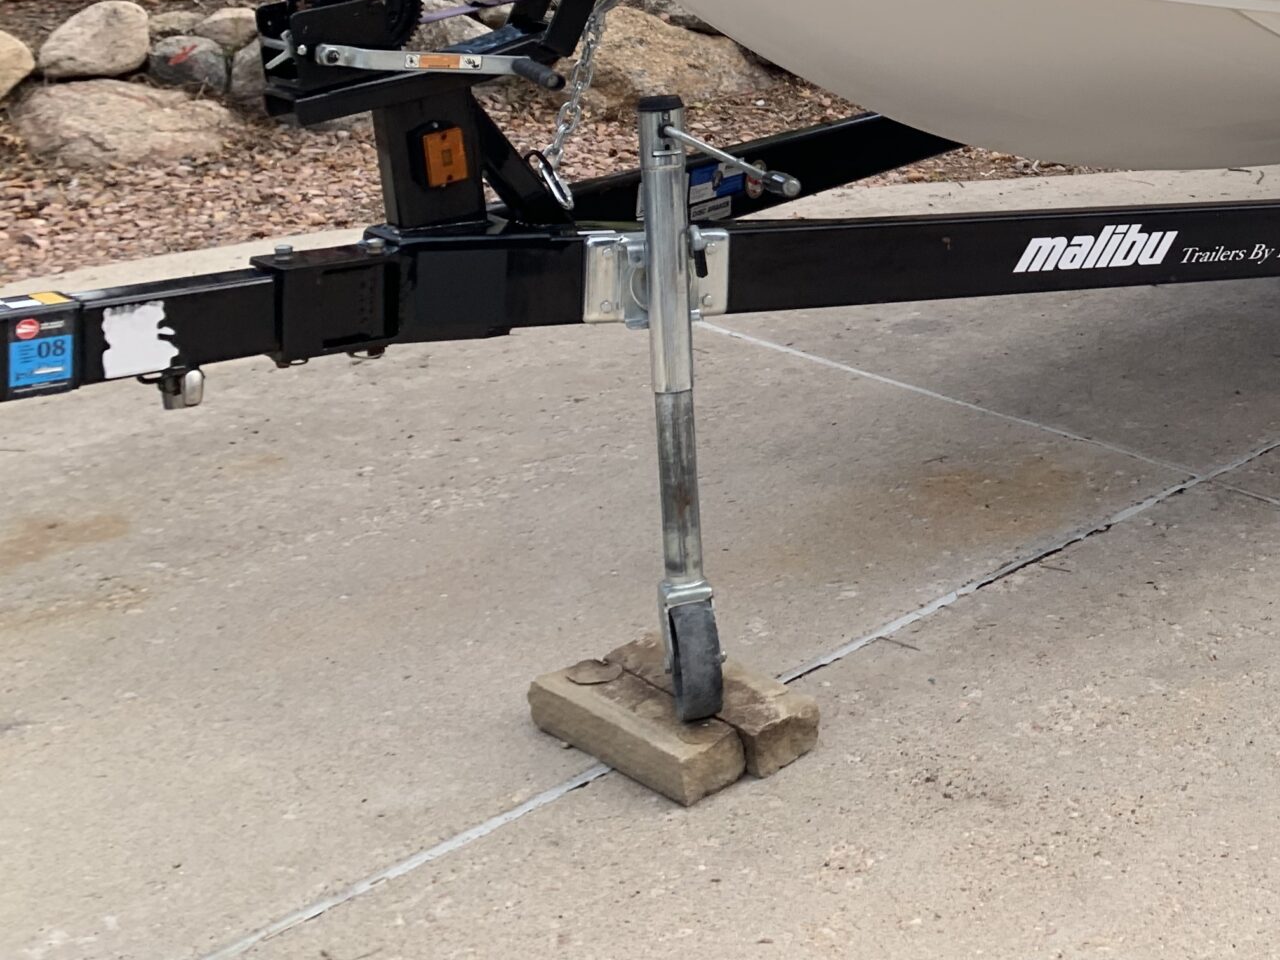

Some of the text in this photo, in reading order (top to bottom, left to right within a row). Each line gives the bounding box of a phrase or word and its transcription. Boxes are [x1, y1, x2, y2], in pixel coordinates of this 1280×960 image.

[1012, 224, 1179, 273] malibu
[1180, 245, 1246, 265] Trailers
[1248, 243, 1275, 265] By
[38, 339, 65, 358] 08
